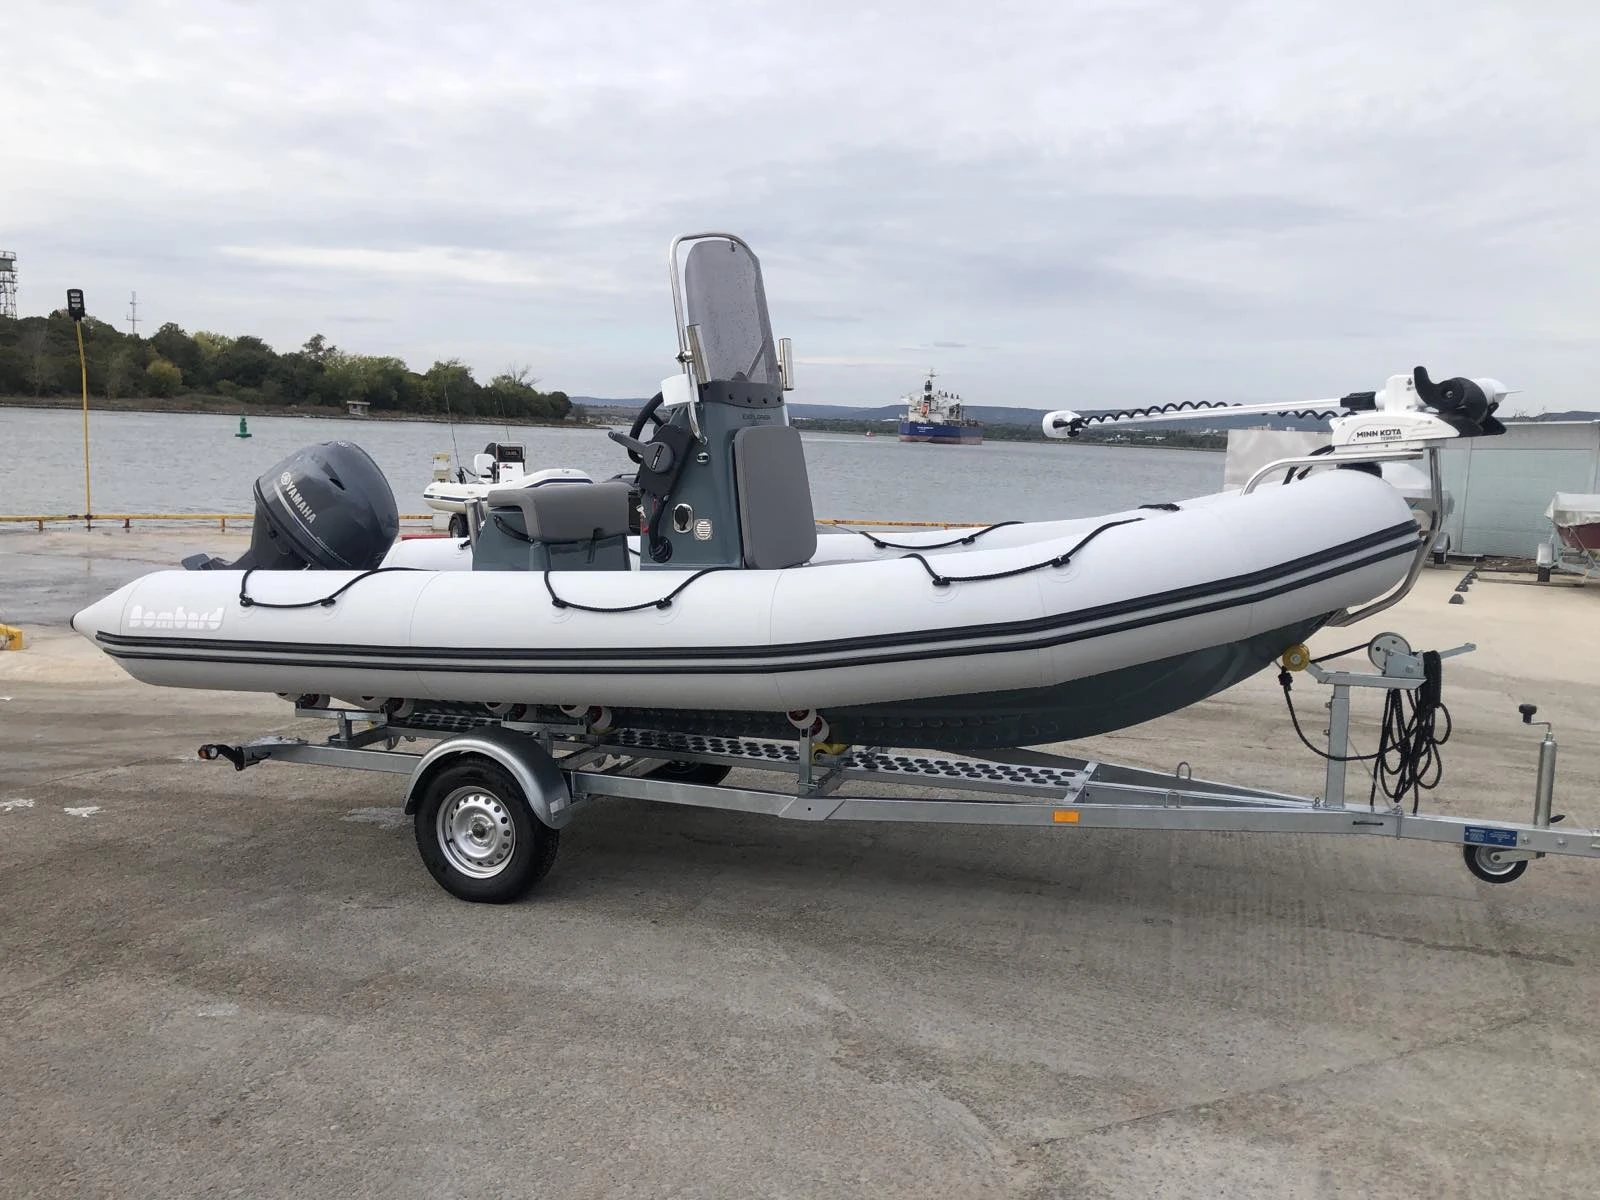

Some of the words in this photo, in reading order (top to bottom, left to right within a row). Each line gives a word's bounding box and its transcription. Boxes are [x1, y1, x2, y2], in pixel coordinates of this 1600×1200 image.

[1356, 430, 1378, 438] MINN
[1379, 428, 1402, 436] KOTA
[286, 481, 317, 524] YAMAHA
[128, 604, 225, 631] Bombard
